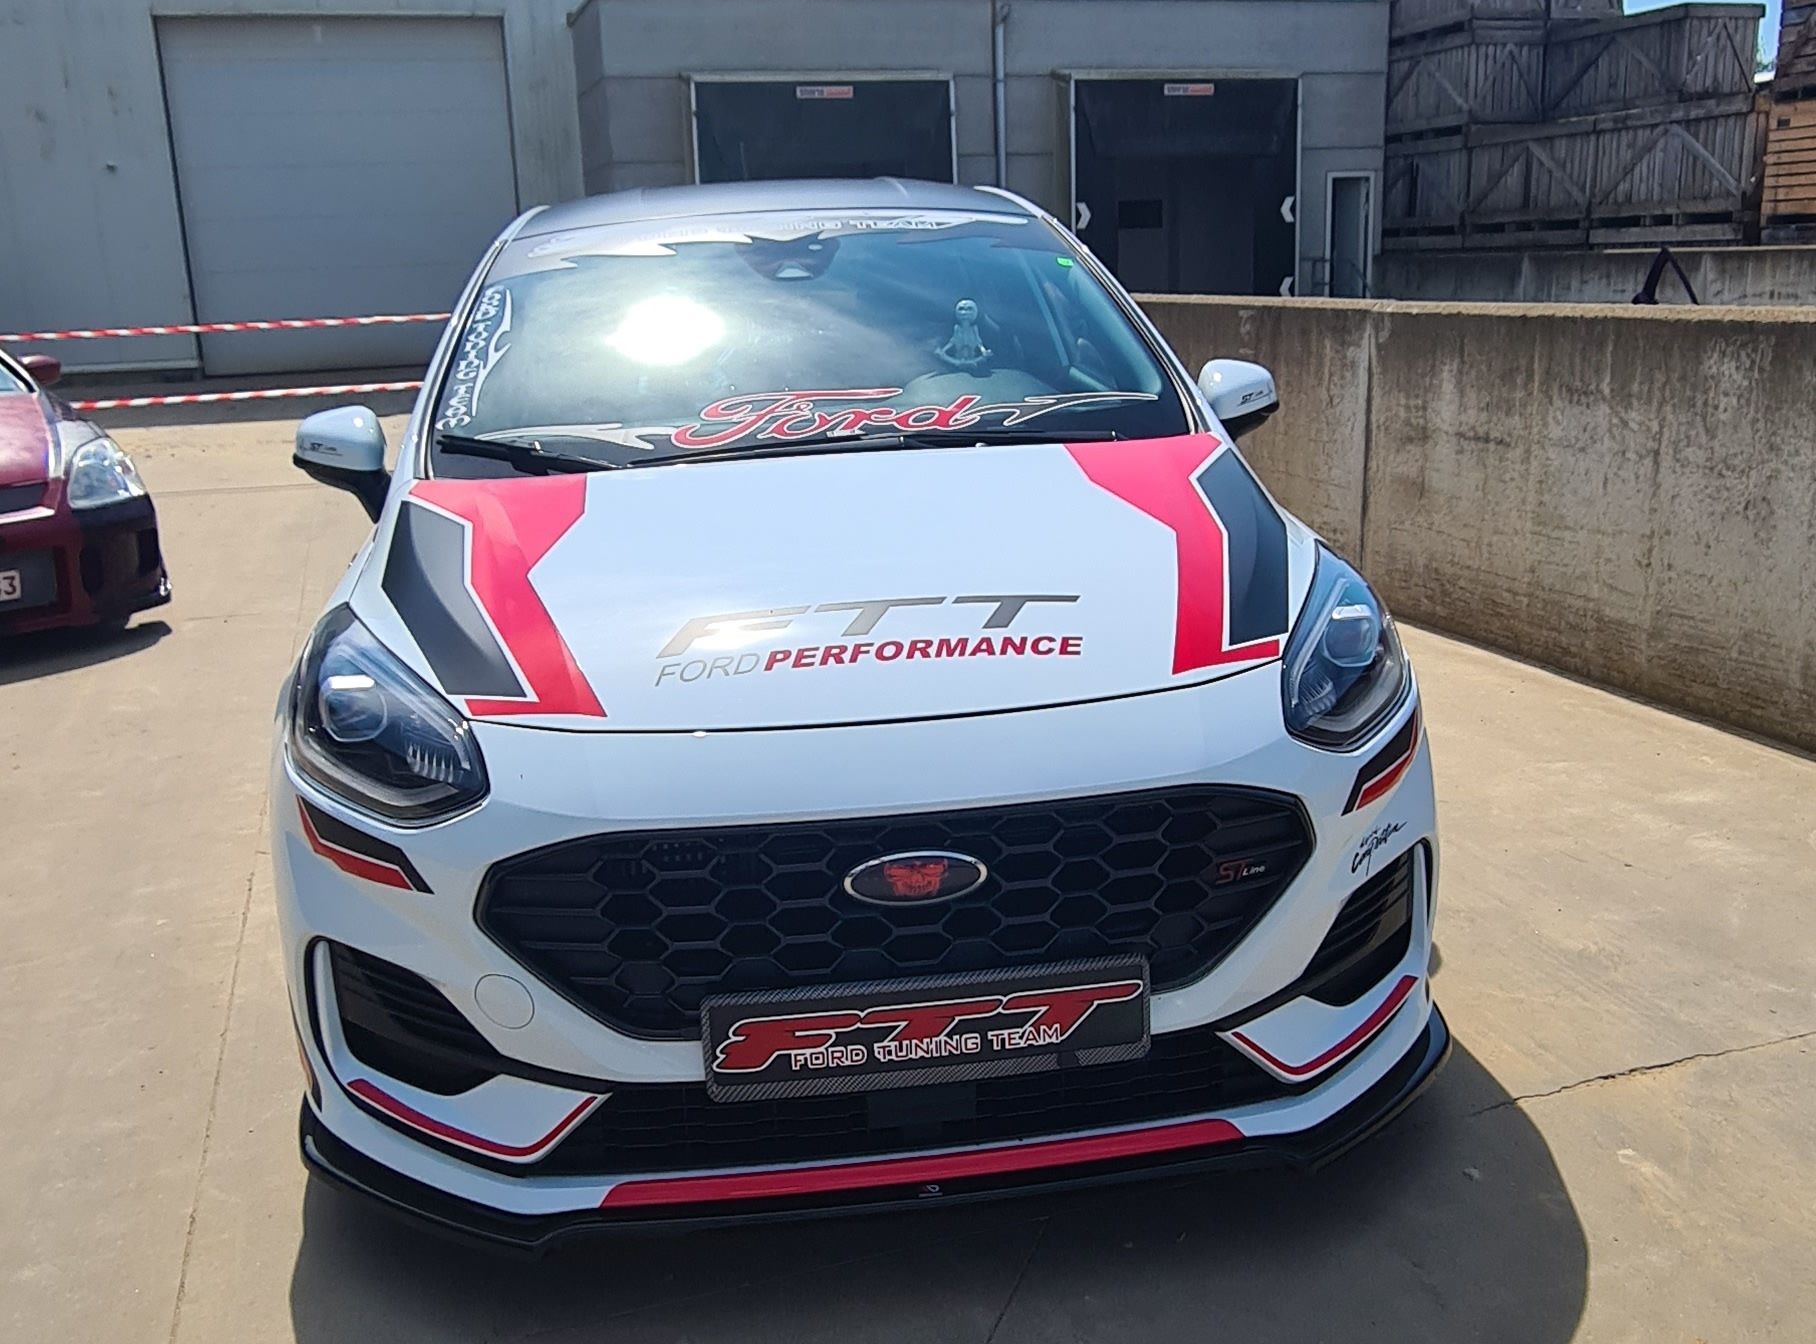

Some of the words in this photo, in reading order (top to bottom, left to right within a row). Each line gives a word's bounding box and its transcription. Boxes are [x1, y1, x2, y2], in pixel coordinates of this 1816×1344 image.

[670, 388, 981, 449] Ford
[0, 575, 17, 596] 3
[655, 594, 1081, 659] FTT
[763, 635, 1084, 672] PERFORMANCE
[712, 980, 1143, 1073] FTT
[791, 1049, 868, 1070] FORD
[875, 1033, 982, 1062] TUNING
[988, 1023, 1063, 1051] TEAM
